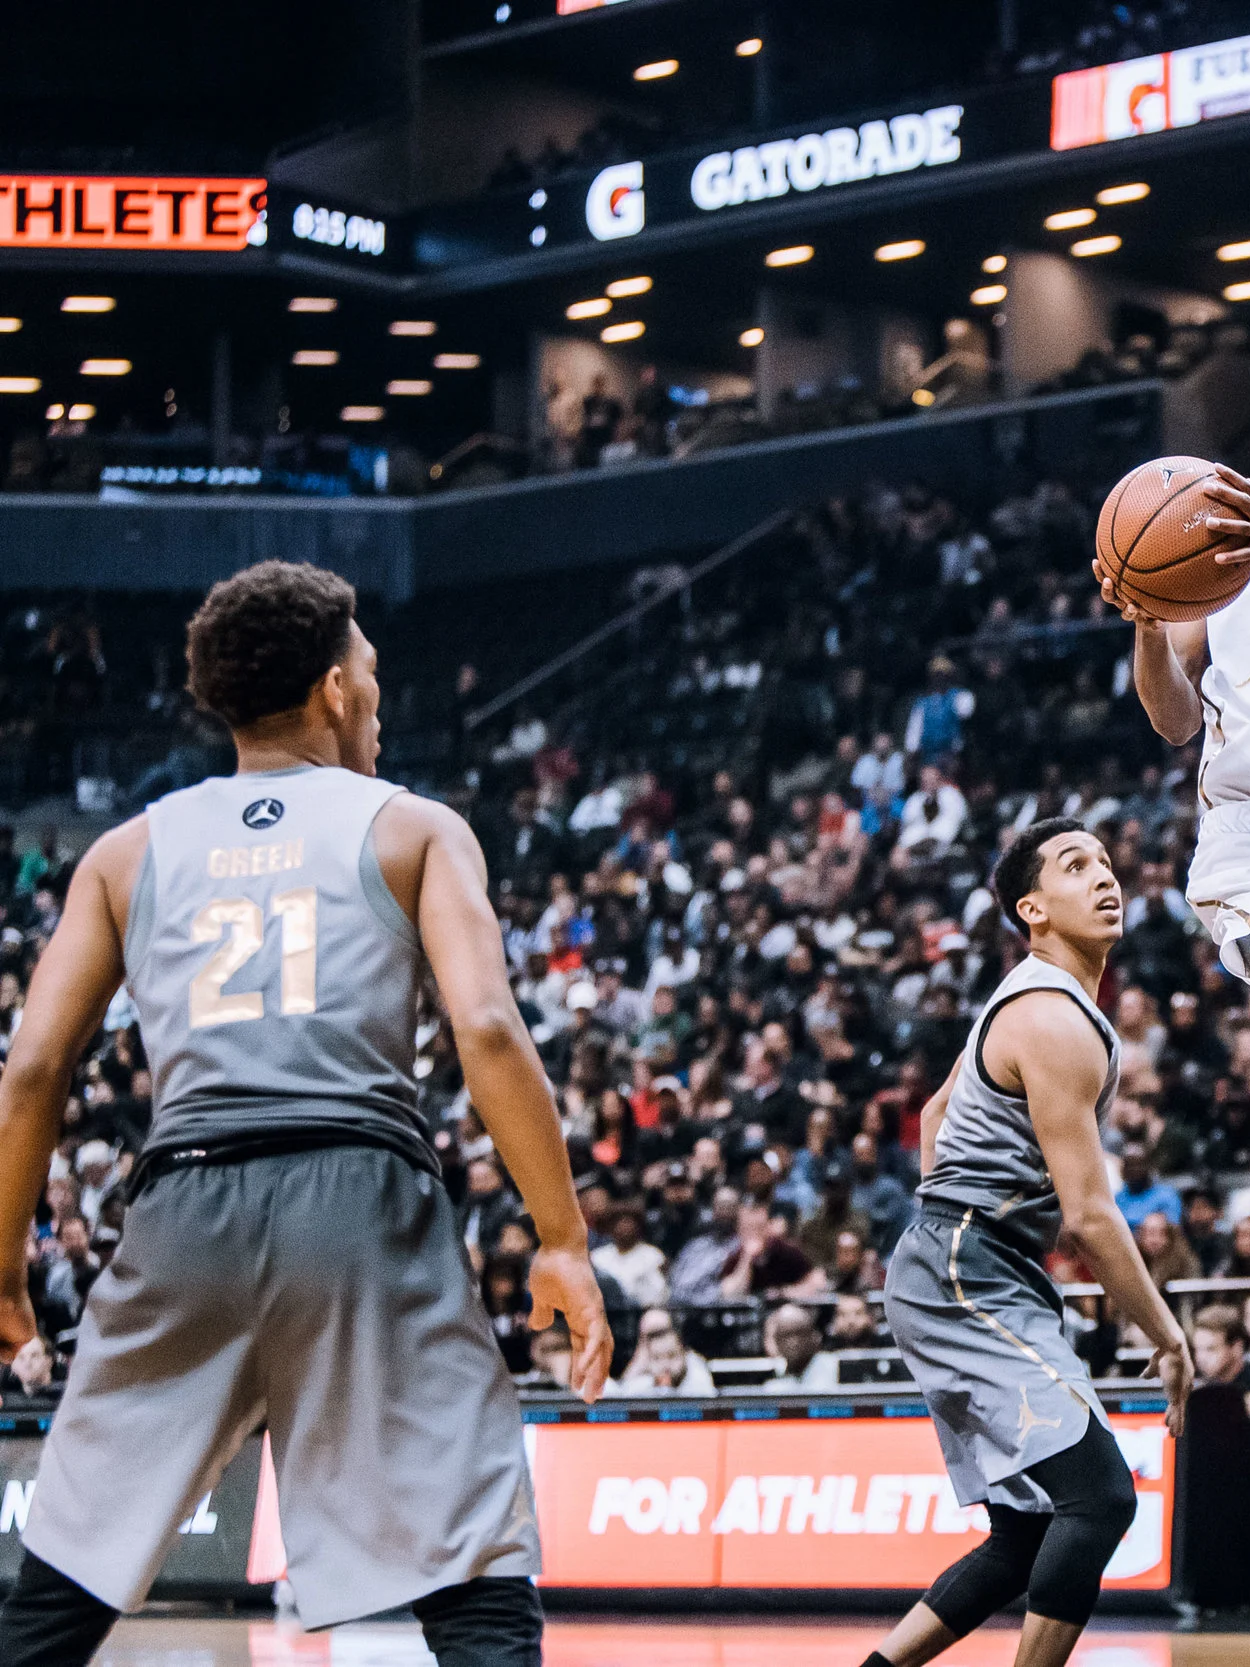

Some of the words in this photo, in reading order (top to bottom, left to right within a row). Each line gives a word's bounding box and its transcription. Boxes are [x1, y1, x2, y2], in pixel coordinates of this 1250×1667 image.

[586, 160, 645, 241] G
[690, 104, 964, 211] GATORADE
[208, 837, 304, 879] GREEN
[189, 885, 317, 1029] 21
[588, 1475, 708, 1536] FOR
